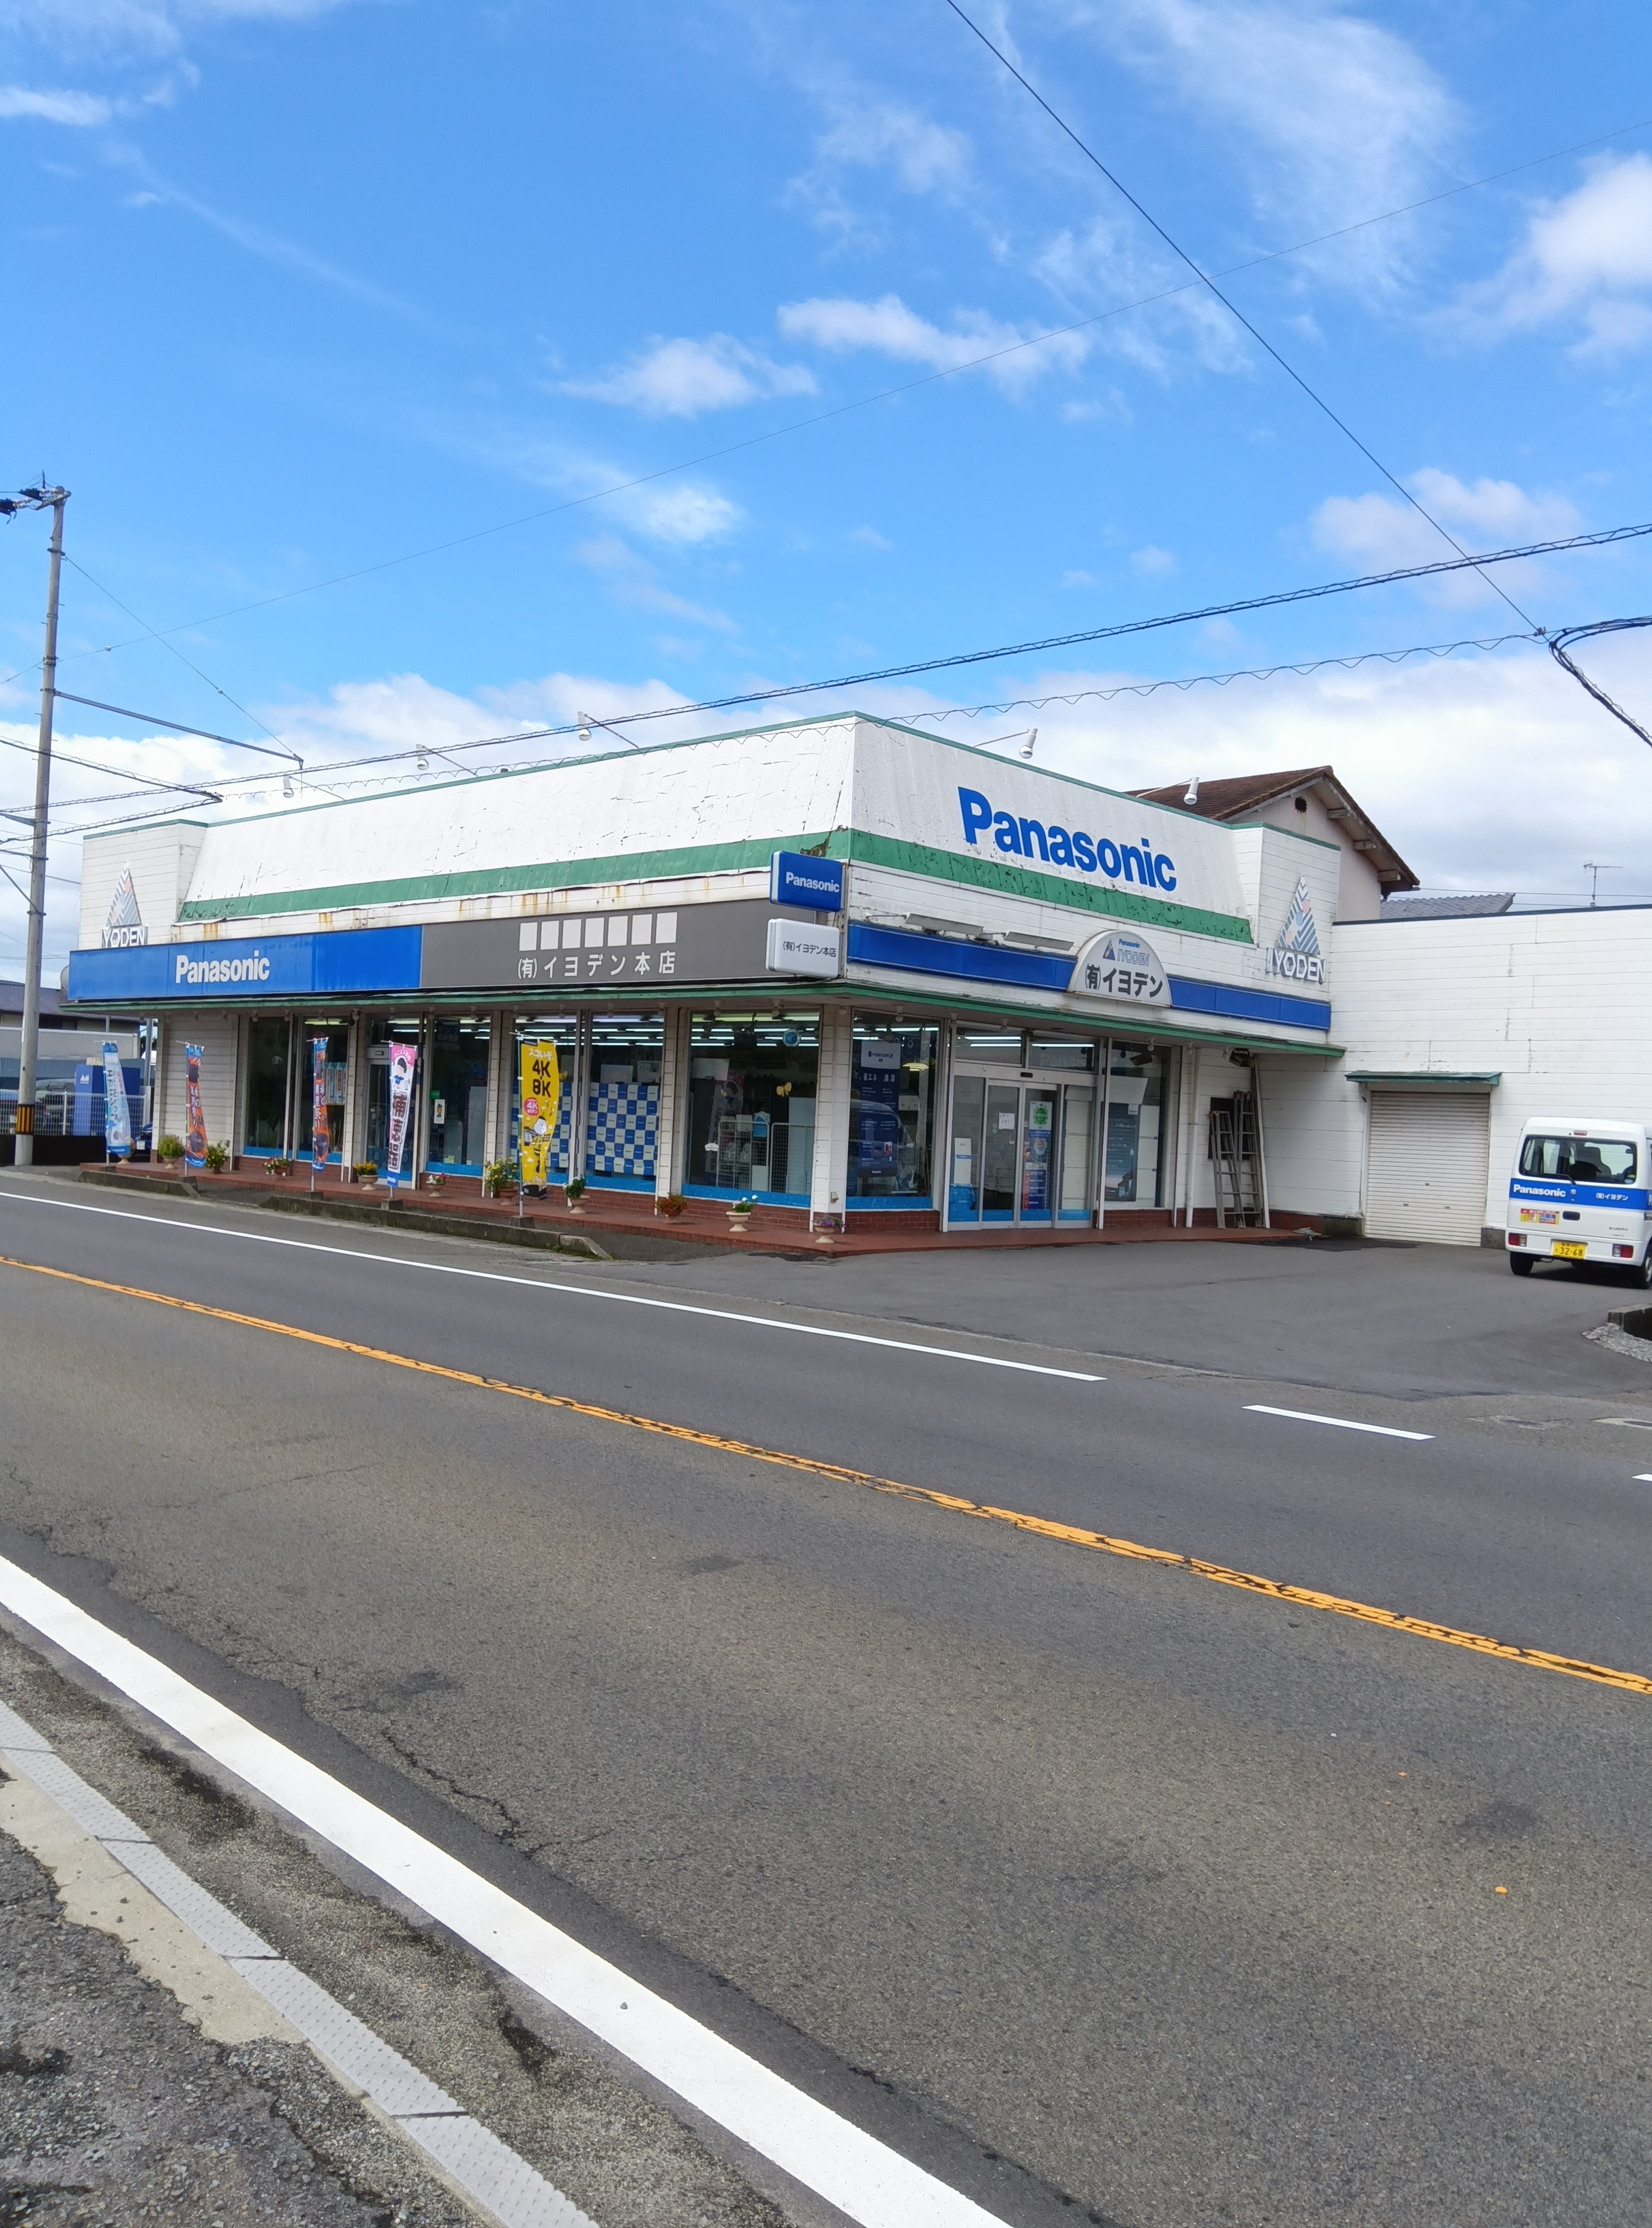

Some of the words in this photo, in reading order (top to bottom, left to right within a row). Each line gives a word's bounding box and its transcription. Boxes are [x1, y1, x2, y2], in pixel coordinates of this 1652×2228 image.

[957, 786, 1177, 892] Panasonic
[786, 871, 840, 893] Panasonic
[100, 926, 147, 948] IYODEN
[1118, 938, 1141, 948] Panasonic
[783, 940, 837, 958] (有)イヨデン本店
[1117, 948, 1150, 967] IYODEN
[175, 950, 270, 984] Panasonic
[517, 950, 676, 979] (有)イヨデン本店
[1268, 947, 1326, 984] IYODEN
[1085, 963, 1163, 998] (有)イヨデン
[532, 1059, 551, 1078] 4K
[533, 1079, 552, 1098] 8K
[527, 1101, 538, 1110] 4K
[1513, 1184, 1566, 1197] Panasonic
[1559, 1247, 1583, 1256] 32-68
